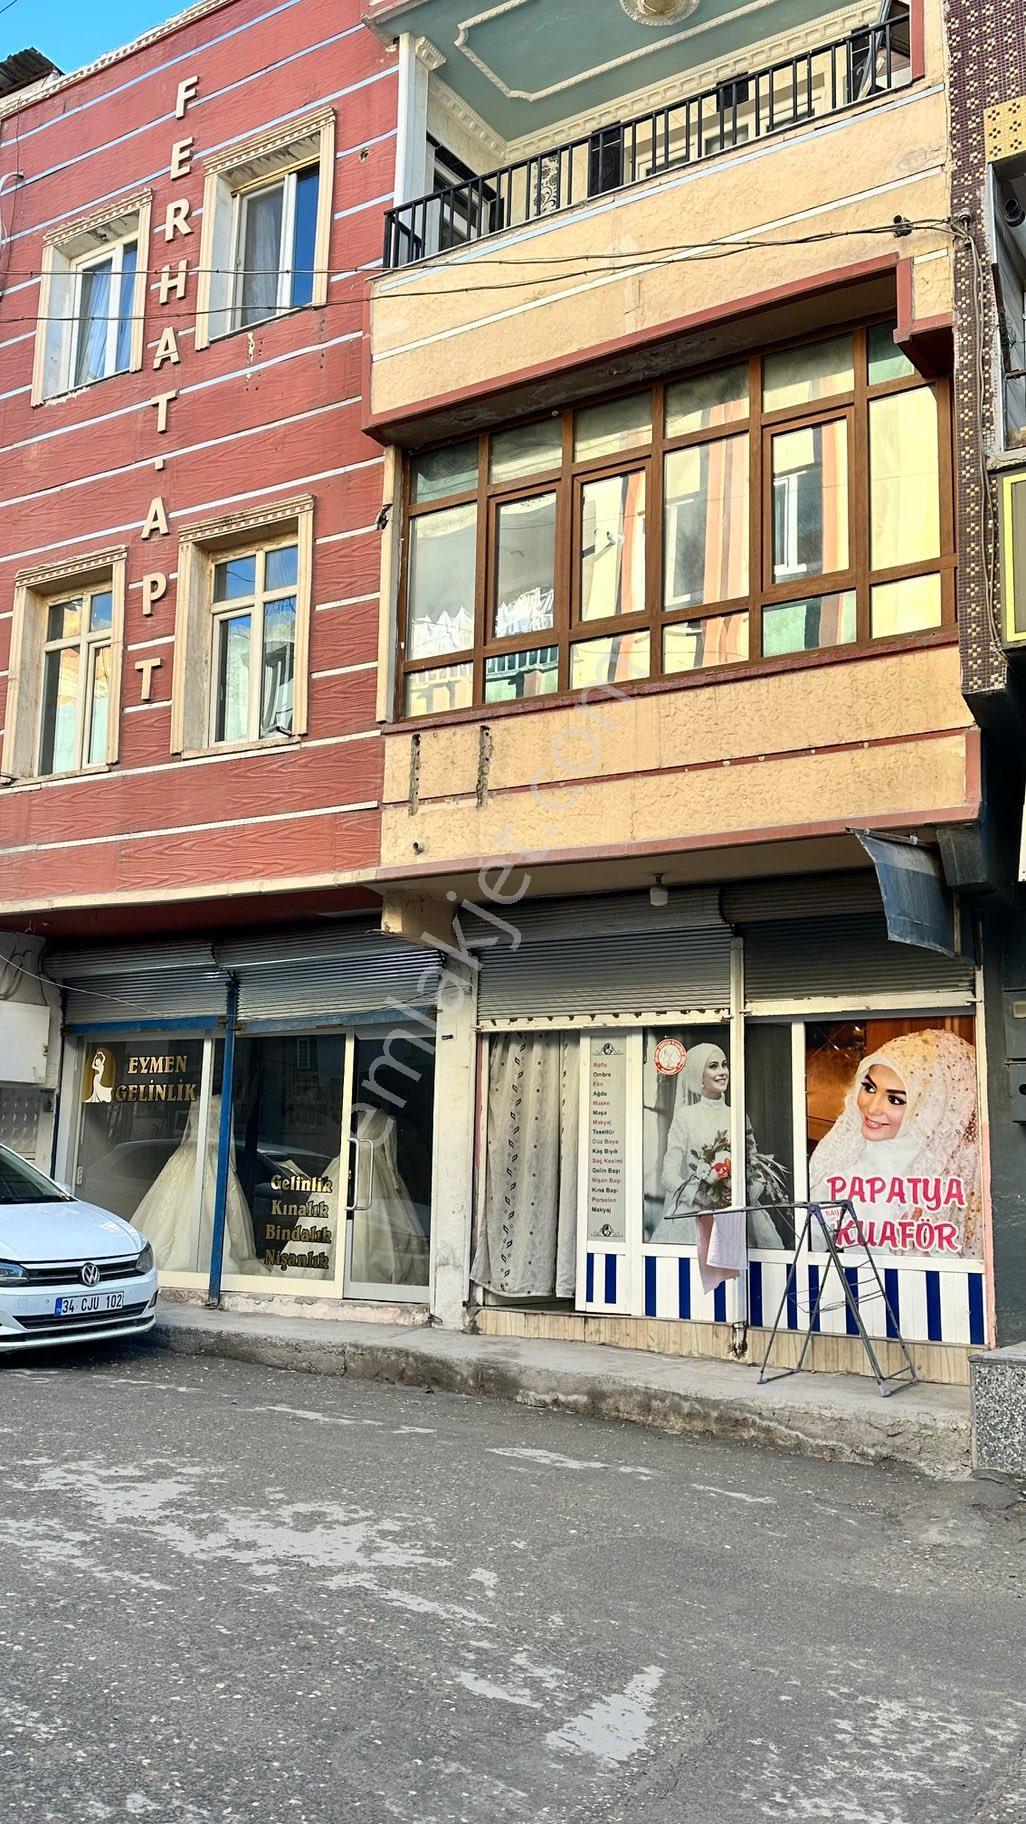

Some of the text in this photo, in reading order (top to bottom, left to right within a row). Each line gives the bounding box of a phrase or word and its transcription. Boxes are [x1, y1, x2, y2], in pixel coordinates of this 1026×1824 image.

[134, 496, 171, 702] APT
[347, 652, 649, 1149] emlakjet.com
[127, 1055, 188, 1075] EYMEN
[114, 1078, 197, 1102] GELİNLİK
[270, 1174, 334, 1194] Gelinlik
[826, 1176, 966, 1212] PAPATYA
[271, 1199, 330, 1219] Kınalık
[264, 1224, 333, 1244] Bindalık
[835, 1217, 960, 1251] KUAFÖR
[264, 1248, 331, 1272] Nişanlık
[62, 1299, 75, 1313] 34
[81, 1296, 100, 1312] CJU
[106, 1294, 122, 1309] 102
